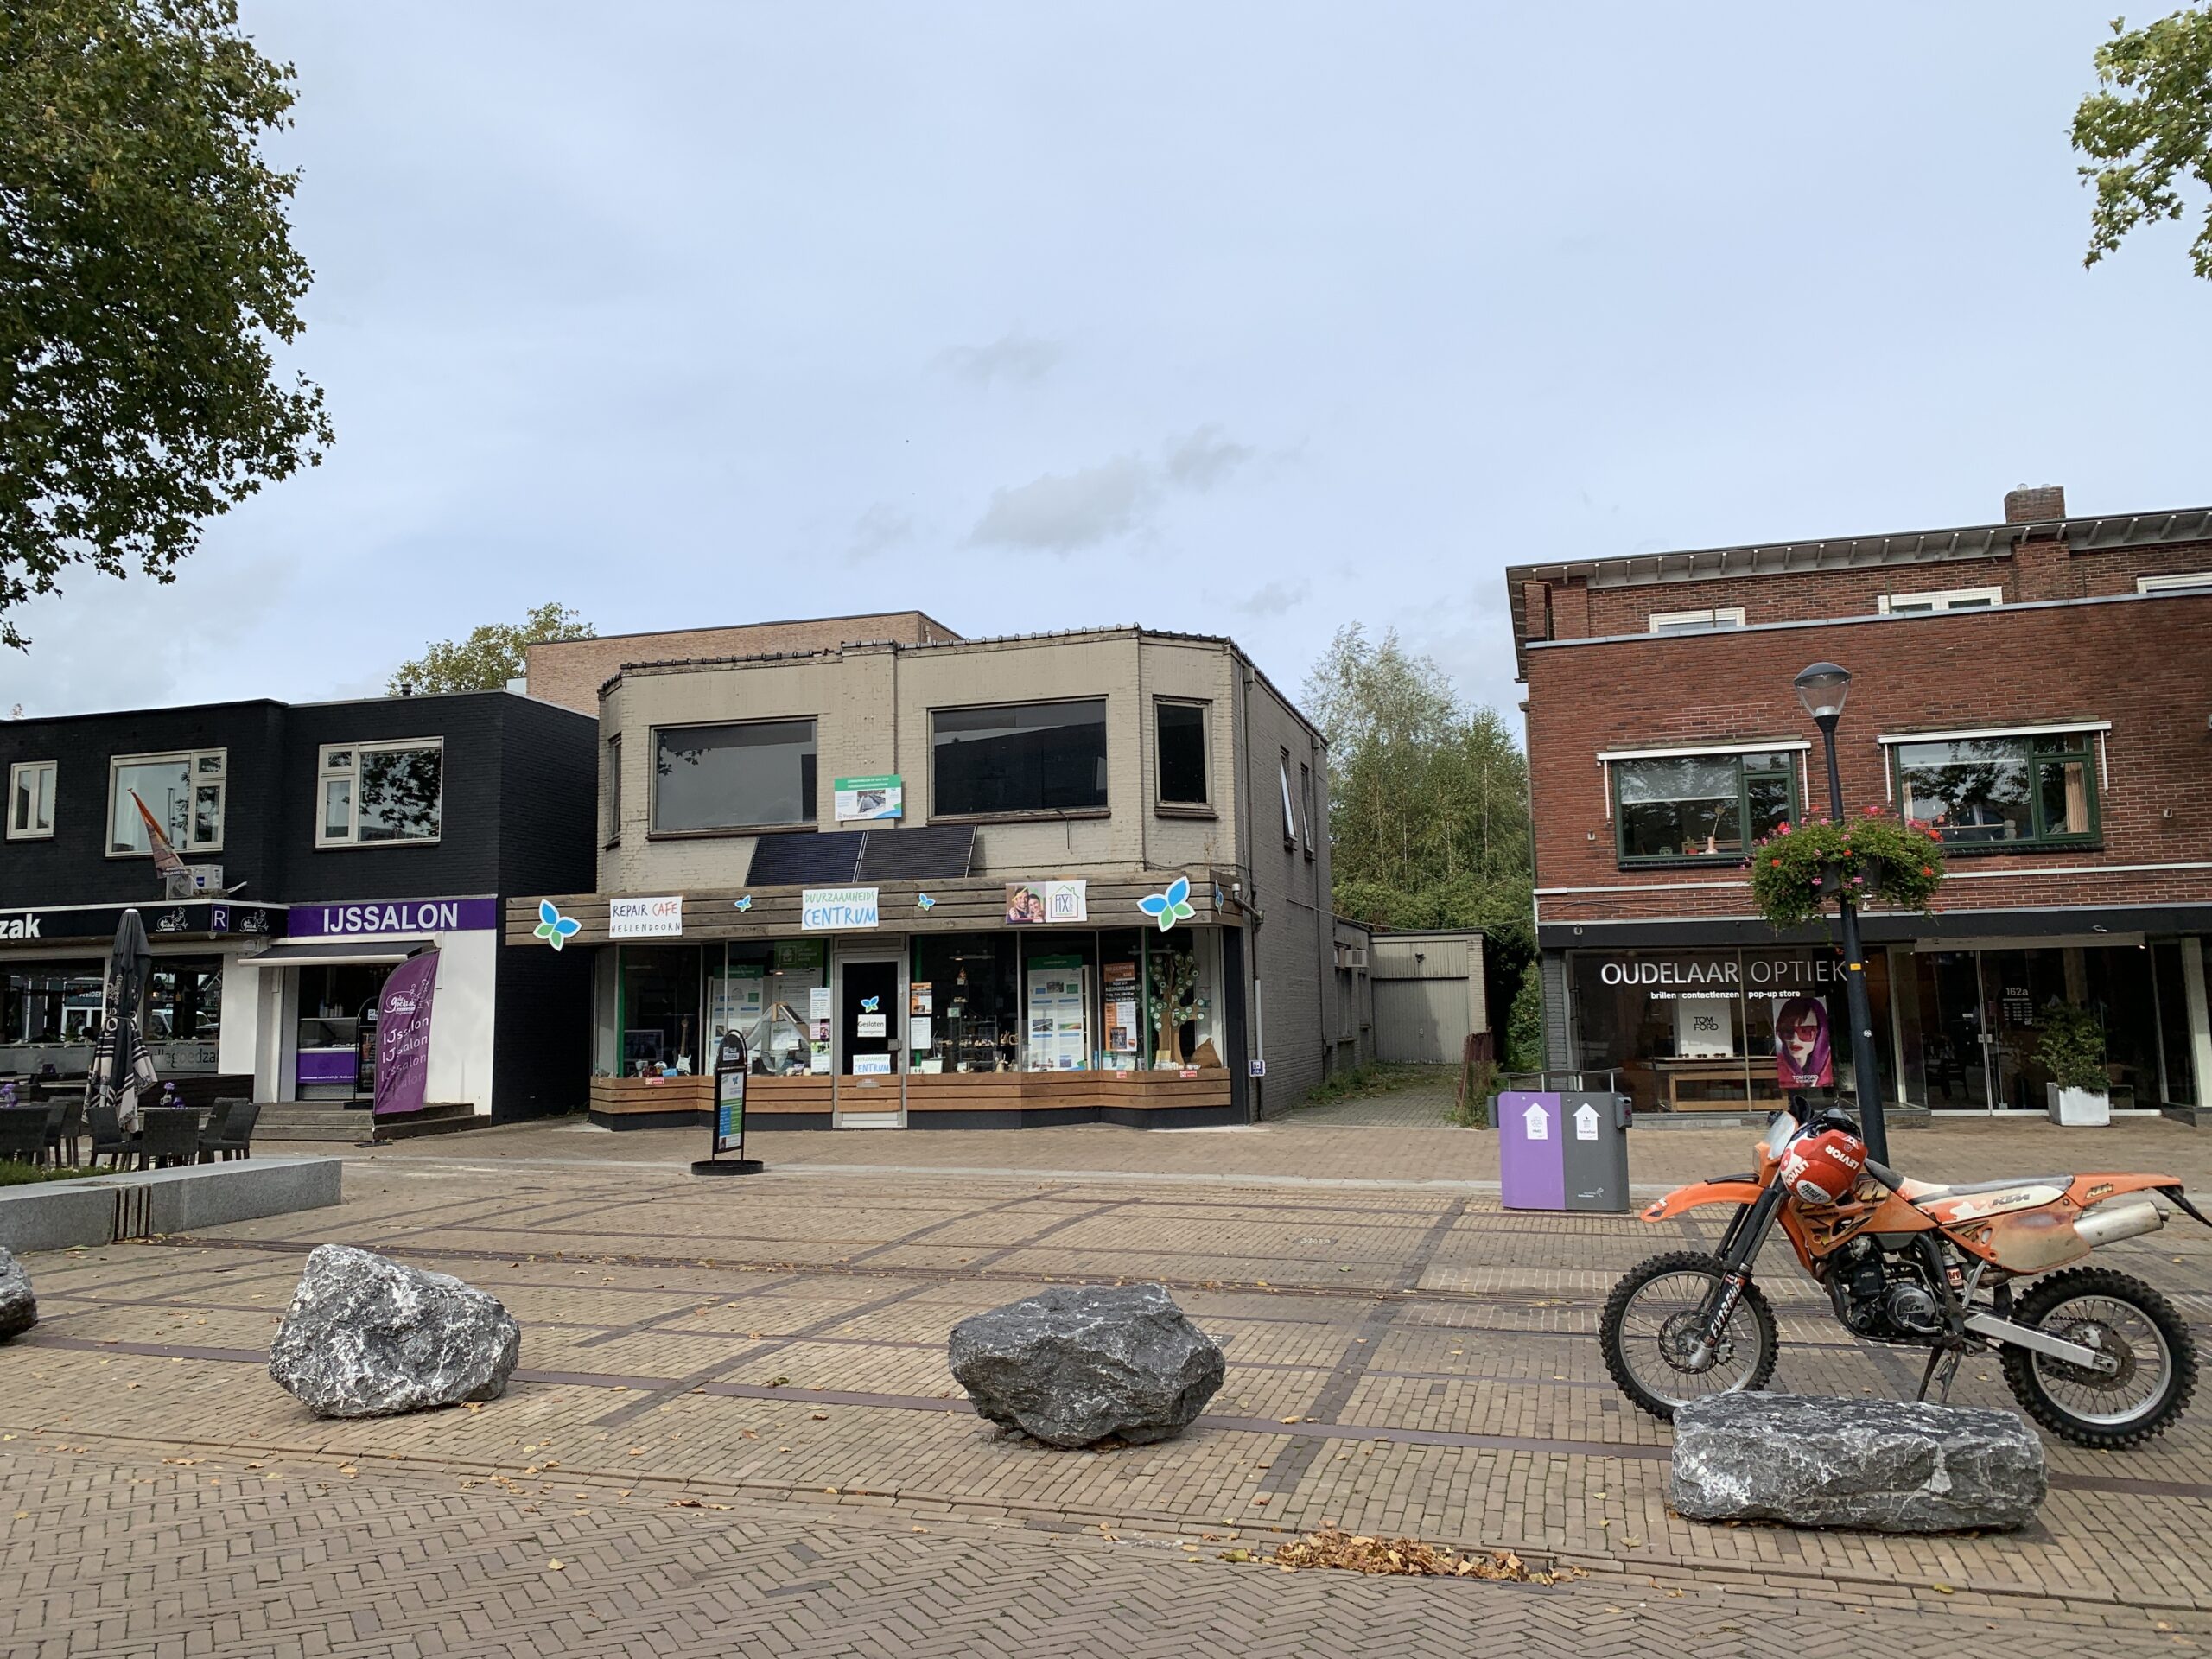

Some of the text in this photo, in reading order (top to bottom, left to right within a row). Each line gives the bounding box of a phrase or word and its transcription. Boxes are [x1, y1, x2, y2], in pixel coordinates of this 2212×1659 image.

[804, 890, 875, 904] DUURZAAMHEIDS
[323, 902, 458, 933] IJSSALON
[613, 901, 678, 918] REPAIR CAFE
[804, 906, 877, 928] CENTRUM
[213, 910, 226, 927] R
[611, 921, 681, 933] HELLENDOORN
[1600, 960, 1847, 985] OUDELAAR OPTIEK
[1650, 991, 1676, 1000] brillen
[1748, 990, 1777, 1000] pop-up
[2005, 987, 2029, 996] 162a
[854, 1064, 889, 1073] CENTRUM
[1825, 1144, 1859, 1170] LEVIOR
[1785, 1160, 1810, 1186] LEVIOR
[1992, 1192, 2031, 1206] KTM
